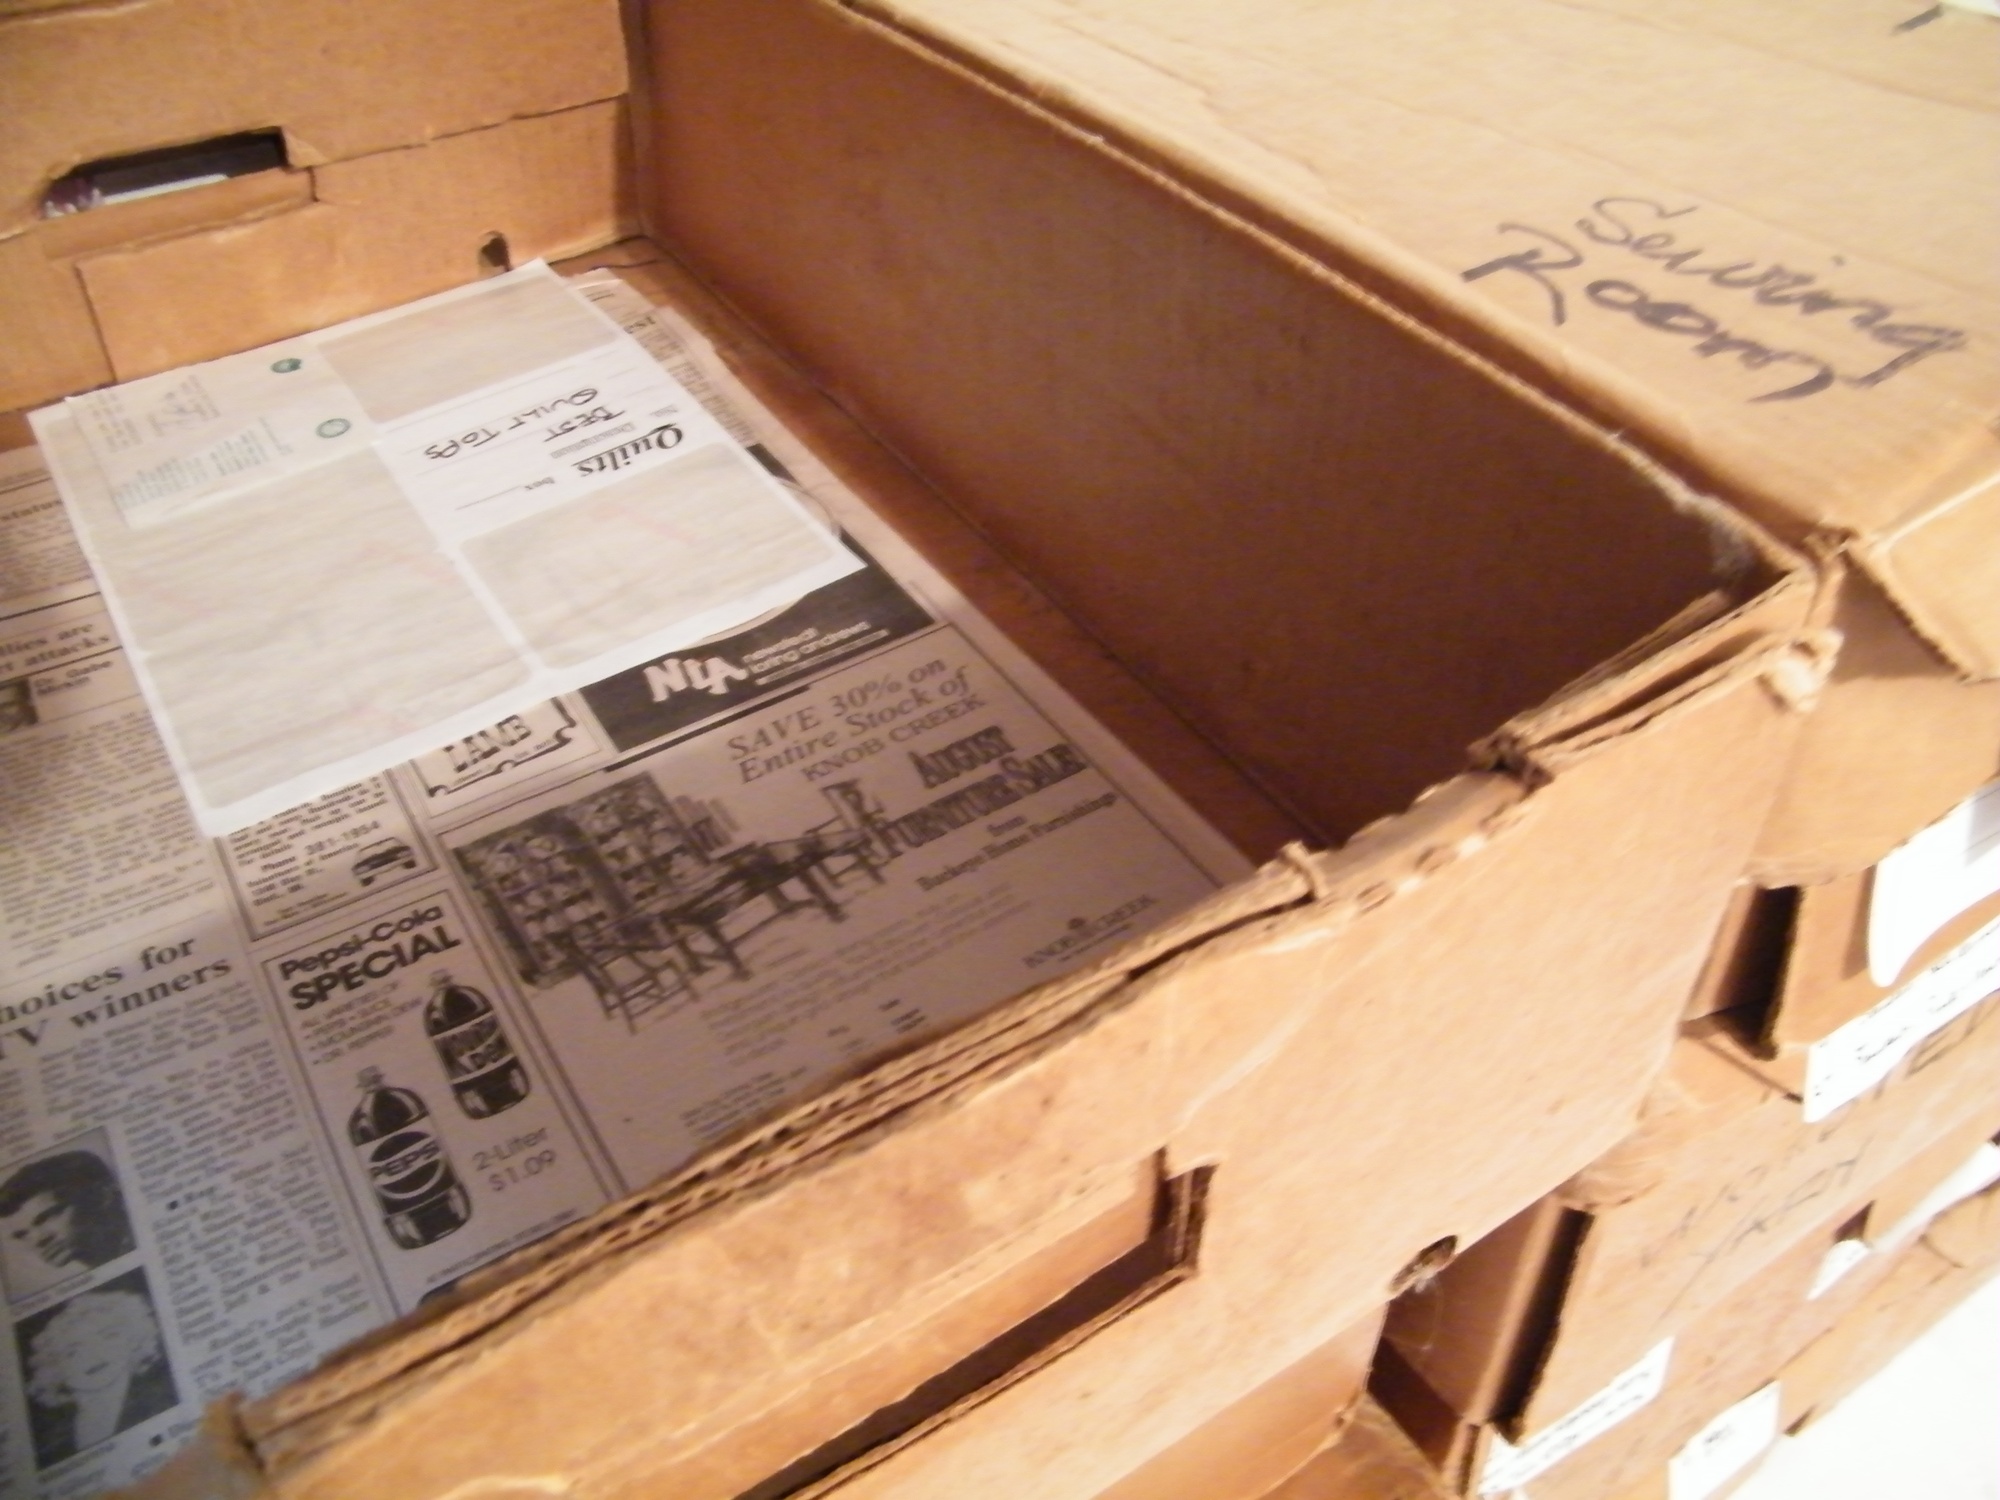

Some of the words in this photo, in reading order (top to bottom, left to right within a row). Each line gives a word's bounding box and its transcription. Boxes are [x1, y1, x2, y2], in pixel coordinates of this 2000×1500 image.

[1461, 223, 1835, 403] Room
[1576, 197, 1966, 387] Sewing
[509, 388, 598, 430] QUILT
[544, 406, 626, 443] BEST
[571, 422, 684, 478] Quilts
[728, 705, 823, 760] SAVE
[833, 677, 900, 717] 30%
[908, 658, 946, 683] on
[737, 729, 840, 785] Entire
[846, 692, 929, 735] Stock
[939, 665, 971, 698] of
[800, 738, 885, 782] KNOB
[888, 697, 986, 744] CREEK
[140, 938, 195, 970] for
[279, 905, 443, 981] Pepsi-Cola
[289, 925, 461, 1010] SPECIAL
[70, 959, 232, 1028] winners
[369, 1141, 441, 1178] PEPSI
[472, 1127, 547, 1171] 2-Liter
[490, 1149, 556, 1192] $1.09
